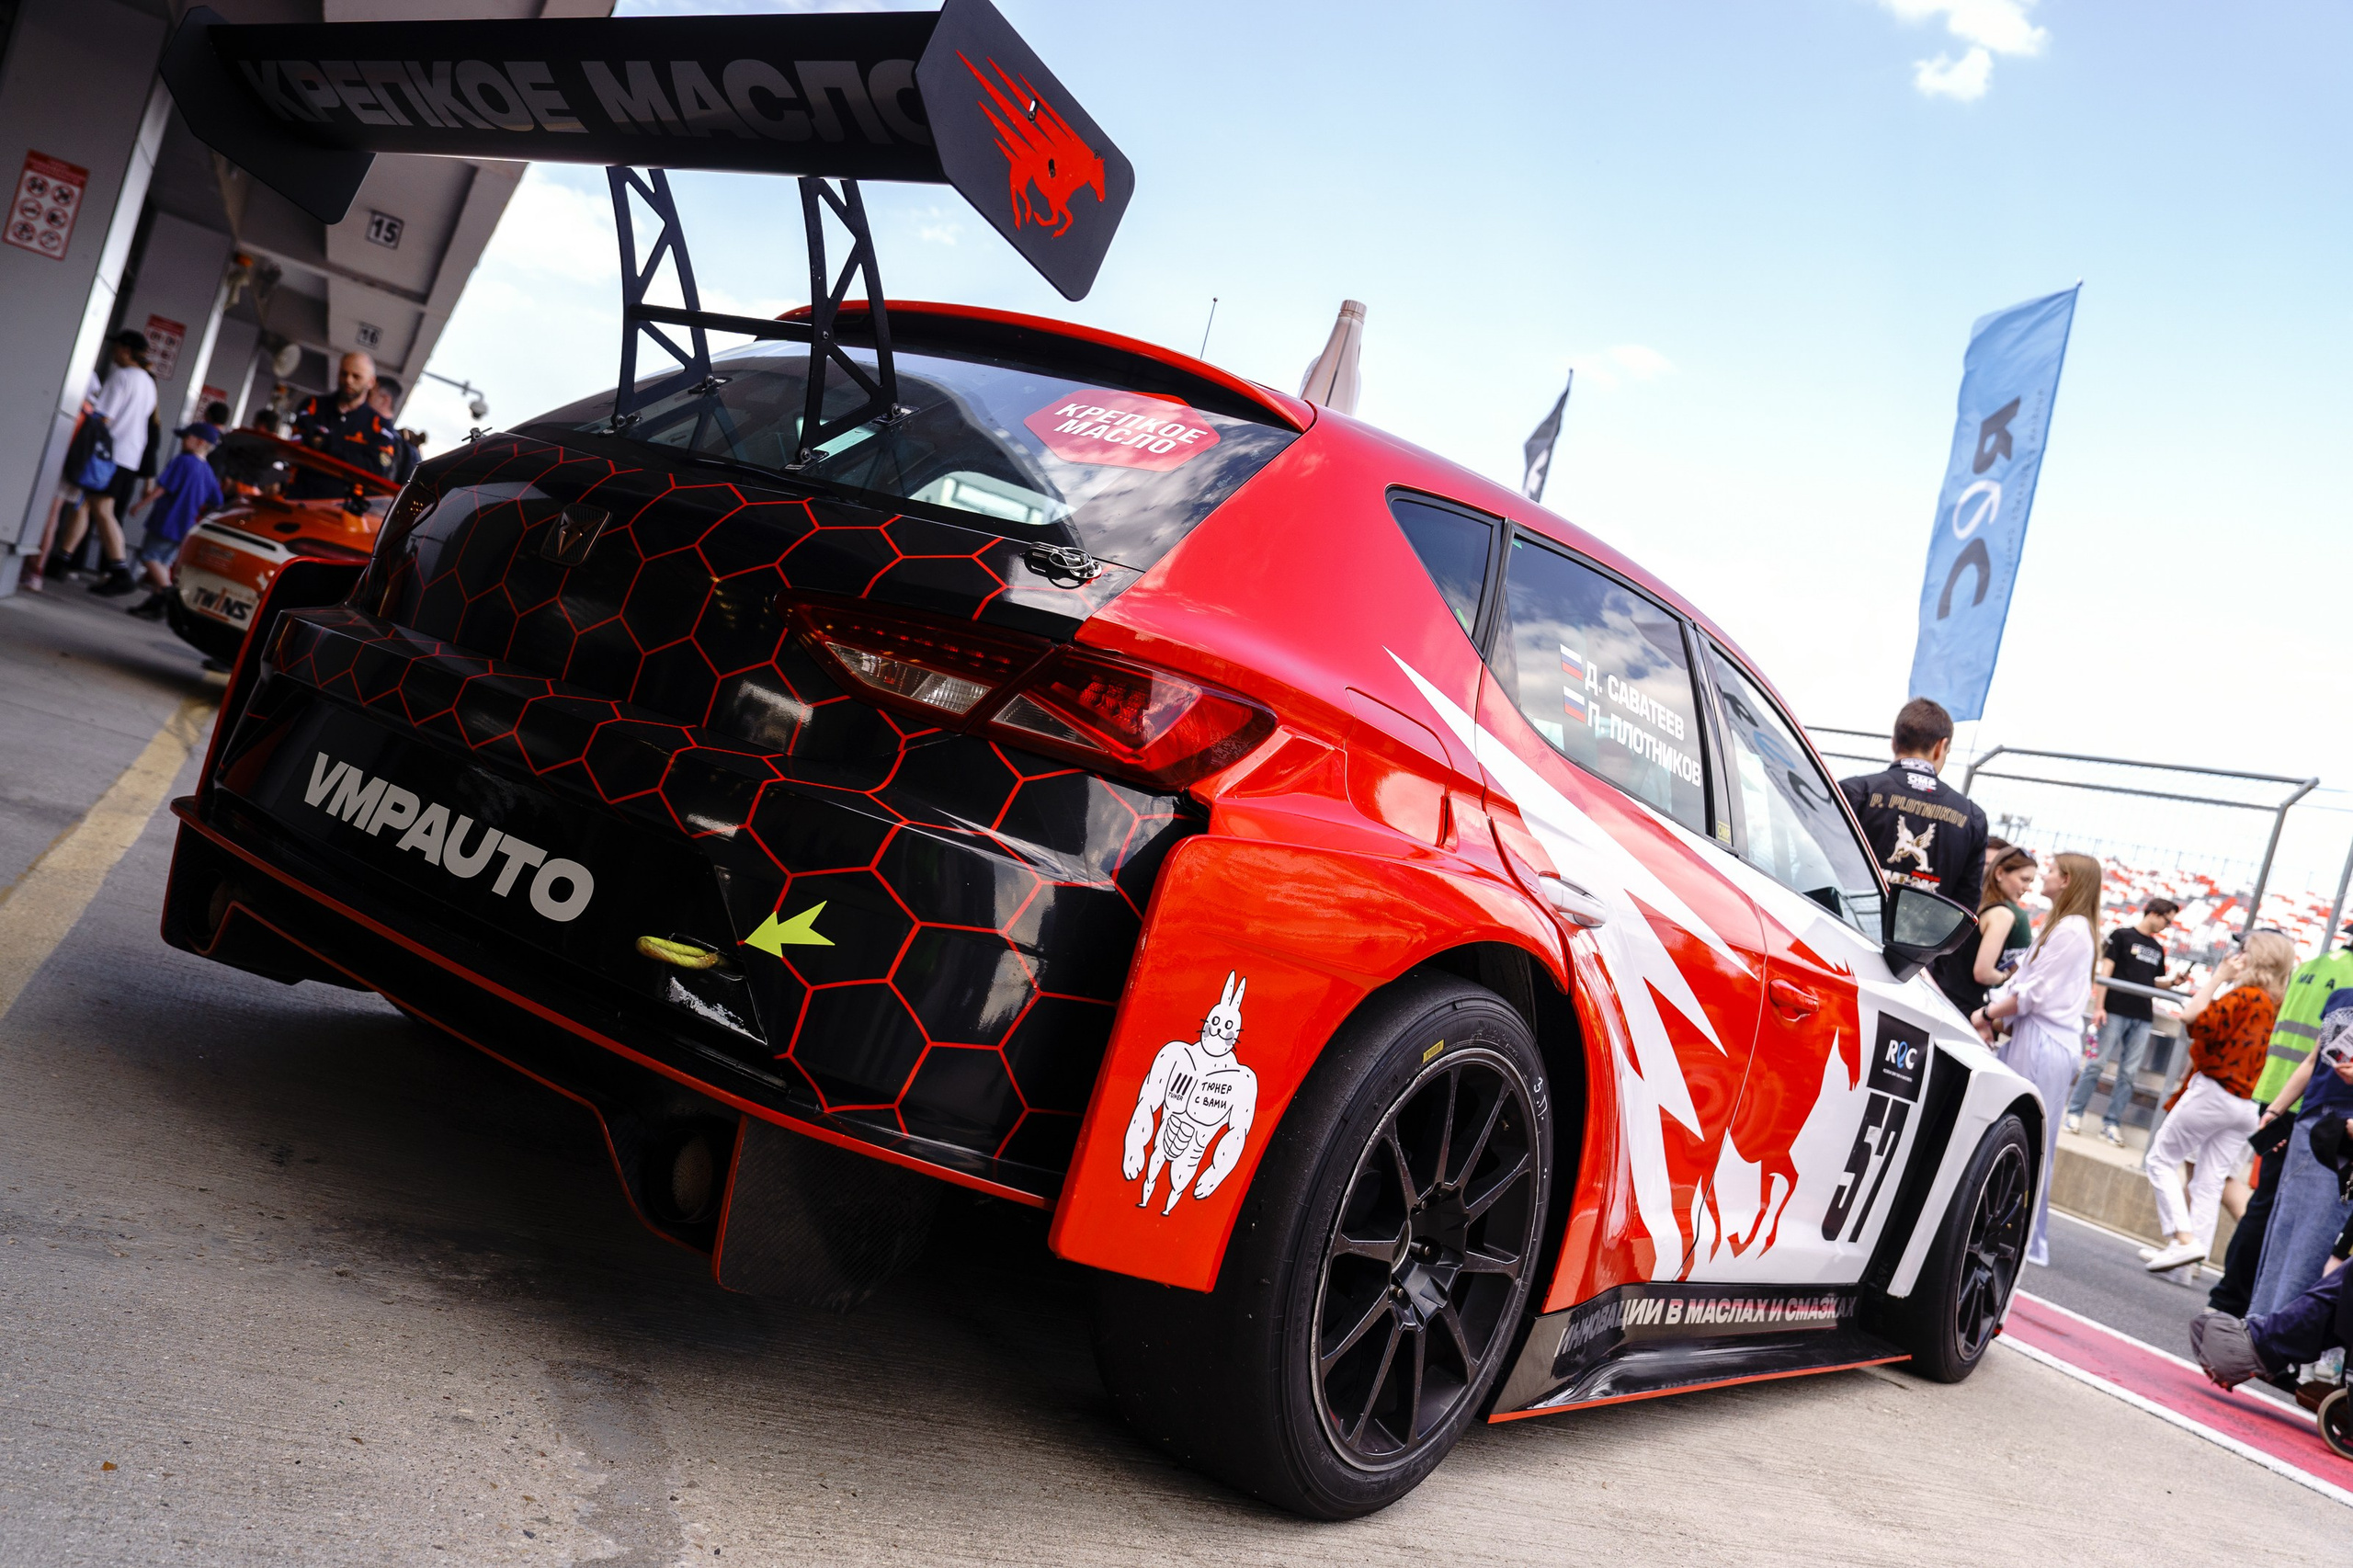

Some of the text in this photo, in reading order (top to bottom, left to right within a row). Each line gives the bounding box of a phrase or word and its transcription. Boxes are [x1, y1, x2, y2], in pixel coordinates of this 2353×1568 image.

[237, 59, 589, 134] КРЕПКОЕ
[370, 217, 398, 244] 15
[1053, 419, 1176, 454] МАСЛО
[1054, 403, 1208, 444] КРЕПКОЕ
[193, 586, 253, 620] TWINS
[1585, 661, 1685, 741] Д. САВАТЕЕВ
[1587, 700, 1606, 734] П.
[1609, 712, 1701, 788] ПЛОТНИКОВ
[1906, 772, 1937, 790] OMP
[1870, 793, 1968, 829] P. PLOTNIKOV
[303, 751, 595, 922] VMPAUTO
[1167, 1091, 1184, 1101] TUNER
[1195, 1096, 1227, 1109] С ВАМИ
[1201, 1082, 1233, 1094] ТЮНЕР
[1821, 1092, 1910, 1243] 57
[1553, 1297, 1857, 1358] ИННОВАЦИИ В МАСЛАХ И СМАЗКАХ
